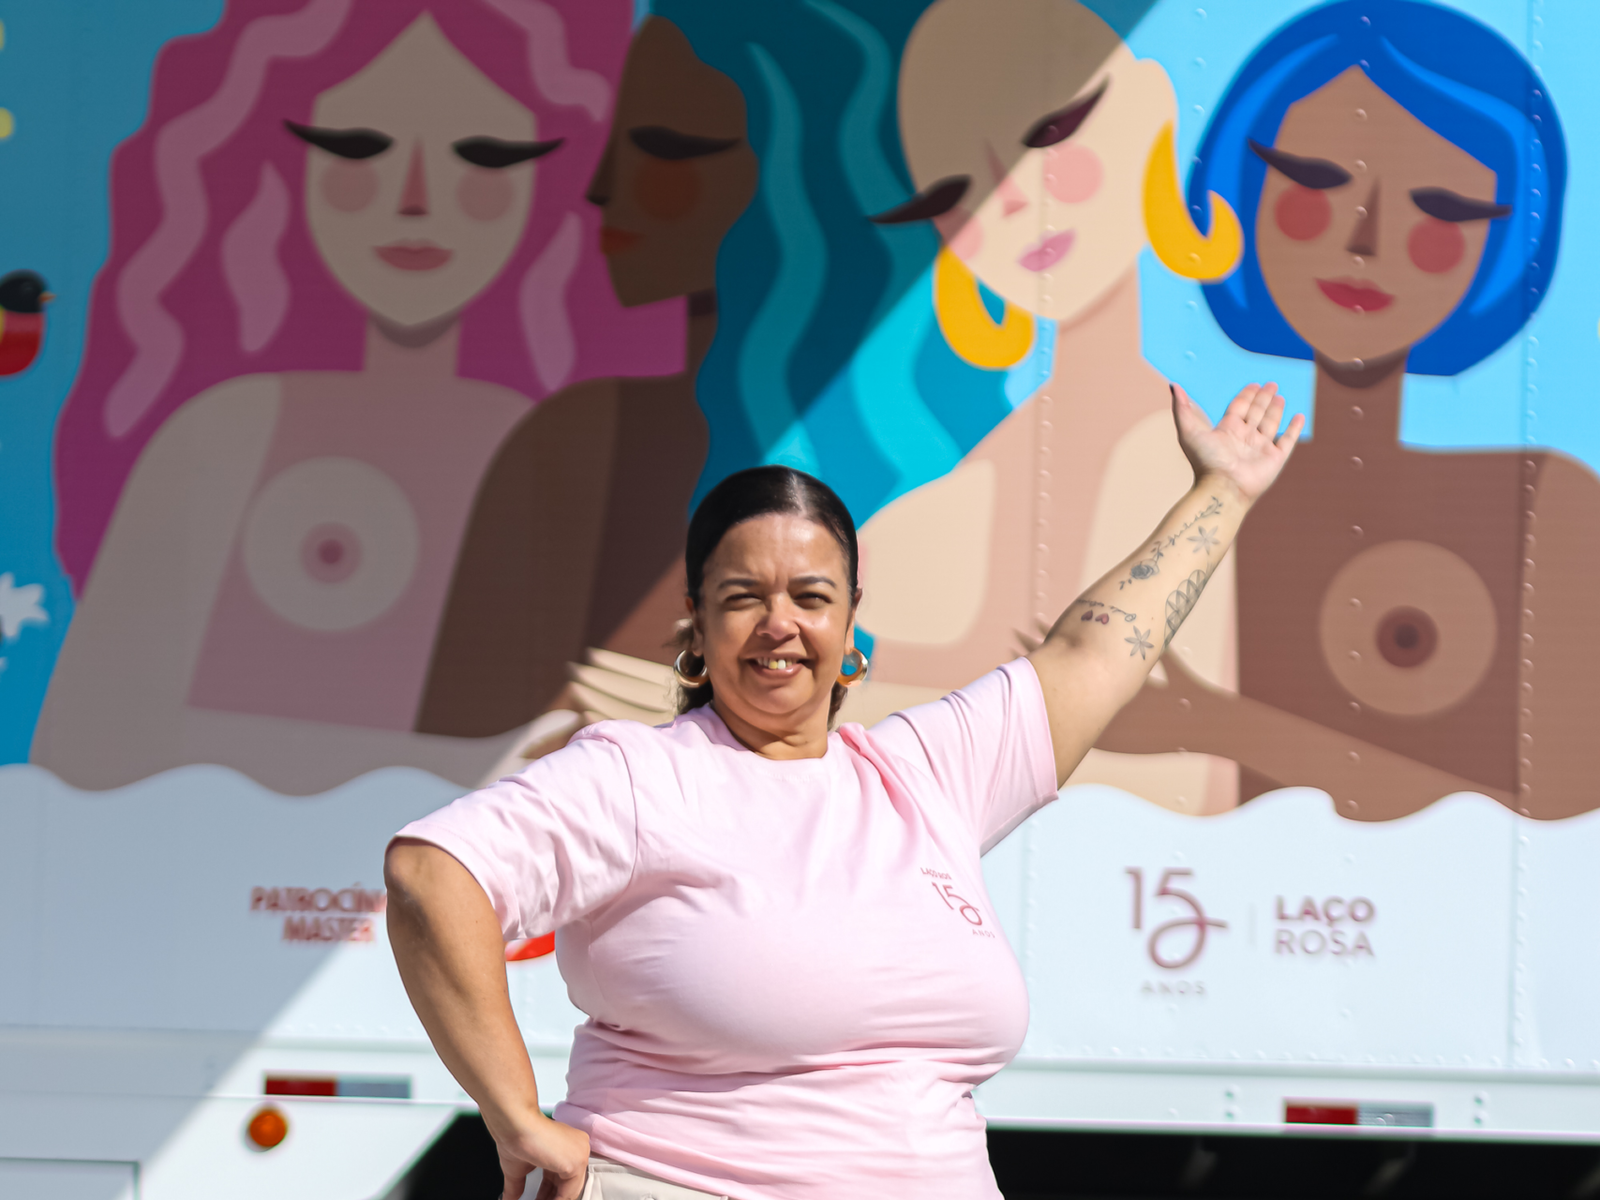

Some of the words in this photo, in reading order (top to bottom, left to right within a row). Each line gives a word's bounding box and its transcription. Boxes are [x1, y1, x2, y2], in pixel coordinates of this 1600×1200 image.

[252, 882, 387, 912] PATROCÍN
[1275, 896, 1375, 927] LAÇO
[1124, 867, 1227, 969] 15
[1275, 930, 1375, 956] ROSA
[1140, 980, 1205, 995] ANOS
